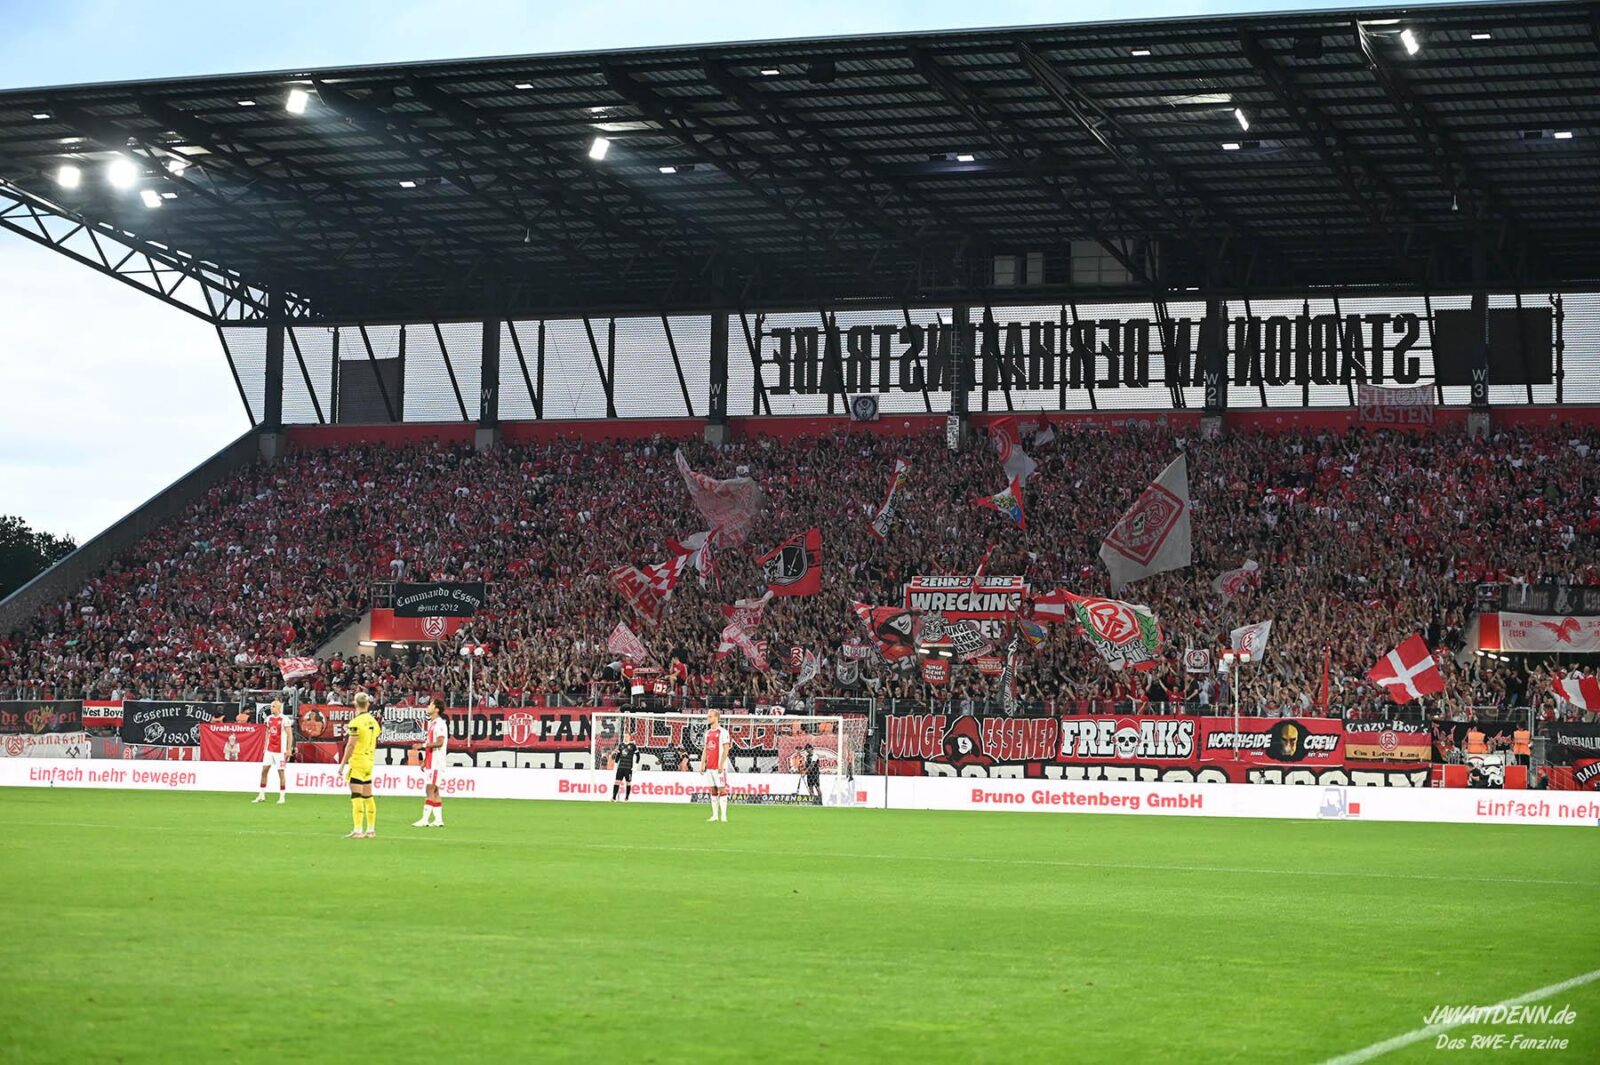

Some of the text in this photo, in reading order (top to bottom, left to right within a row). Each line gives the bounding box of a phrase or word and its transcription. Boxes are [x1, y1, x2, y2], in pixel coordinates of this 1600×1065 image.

[1205, 372, 1219, 385] W
[1472, 368, 1486, 381] W
[481, 388, 493, 400] W
[710, 383, 722, 395] W
[1206, 387, 1217, 401] 2
[1474, 384, 1484, 398] 3
[483, 402, 489, 415] 1
[712, 397, 719, 410] 1
[1359, 404, 1434, 424] KASTEN
[920, 577, 1013, 588] ZEHN JHRE
[396, 587, 481, 608] Commando Essen
[910, 592, 1022, 612] WRECKING
[417, 604, 459, 612] Since 2012
[83, 708, 124, 717] West Boys
[133, 705, 181, 724] Essener
[210, 724, 256, 733] Uralt-Ultras
[539, 714, 615, 742] FANS
[1346, 720, 1429, 736] Crazy-Boy's
[162, 732, 189, 745] 1980
[880, 714, 1058, 761] JUNGE ESSENER
[1061, 719, 1195, 758] FREAKS
[1207, 732, 1338, 750] NORTHSIDE CREW
[30, 767, 83, 782] Einfach
[132, 769, 197, 787] bewegen
[296, 773, 476, 793] Einfac ehr beegen
[761, 793, 815, 802] GARTENBAU
[971, 788, 1203, 810] Bruno Glettenberg GmbH
[1477, 799, 1550, 817] Einfach
